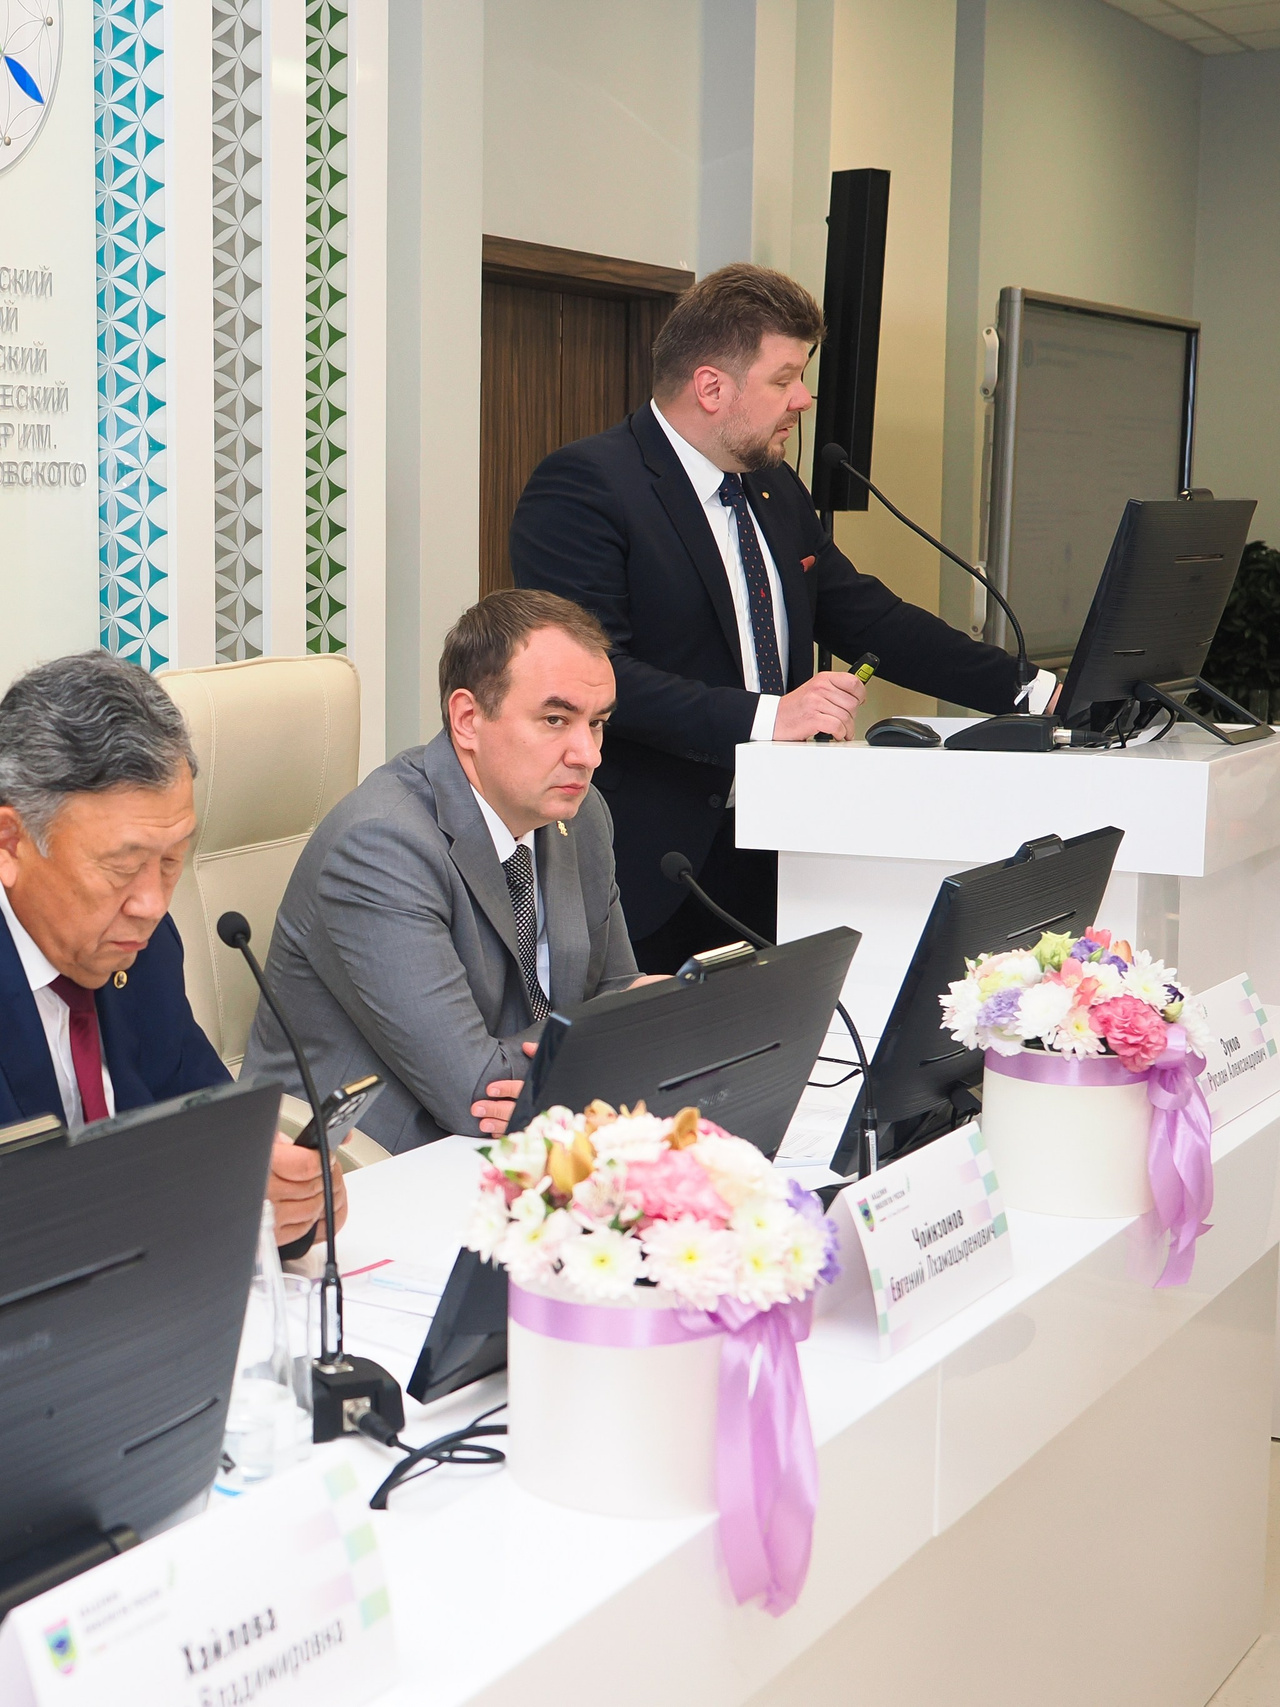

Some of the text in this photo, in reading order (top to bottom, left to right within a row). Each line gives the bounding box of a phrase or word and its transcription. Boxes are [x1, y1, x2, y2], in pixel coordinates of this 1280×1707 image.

[1207, 1047, 1267, 1092] Руслан Александрович
[912, 1210, 964, 1250] Чойнзонов
[890, 1262, 925, 1301] Евгений
